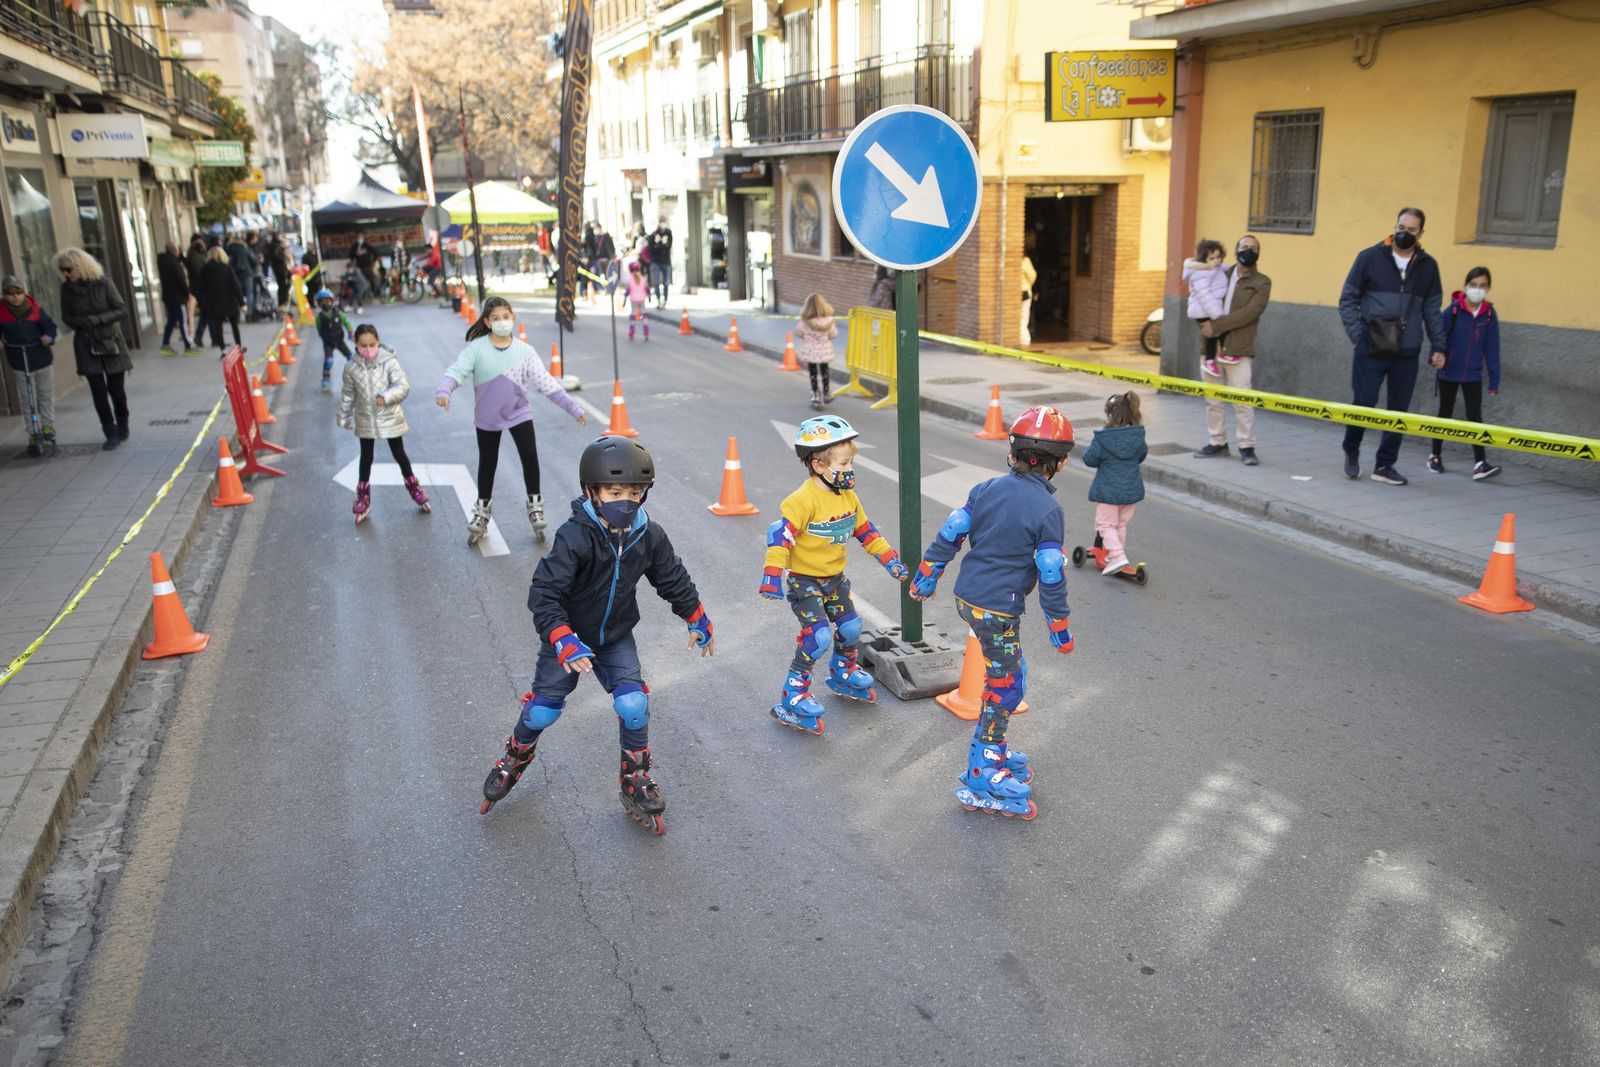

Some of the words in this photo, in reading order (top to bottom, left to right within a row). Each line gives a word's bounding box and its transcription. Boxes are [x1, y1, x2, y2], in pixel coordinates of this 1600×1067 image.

[1059, 54, 1168, 87] Confecciones
[1062, 86, 1080, 117] La
[86, 130, 134, 141] PriVenta
[1161, 383, 1197, 395] MERIDA
[1214, 391, 1256, 403] MERIDA
[1274, 402, 1320, 415] MERIDA
[1343, 412, 1394, 426] MERIDA
[1419, 424, 1479, 439] MERIDA
[1508, 437, 1577, 454] MERIDA
